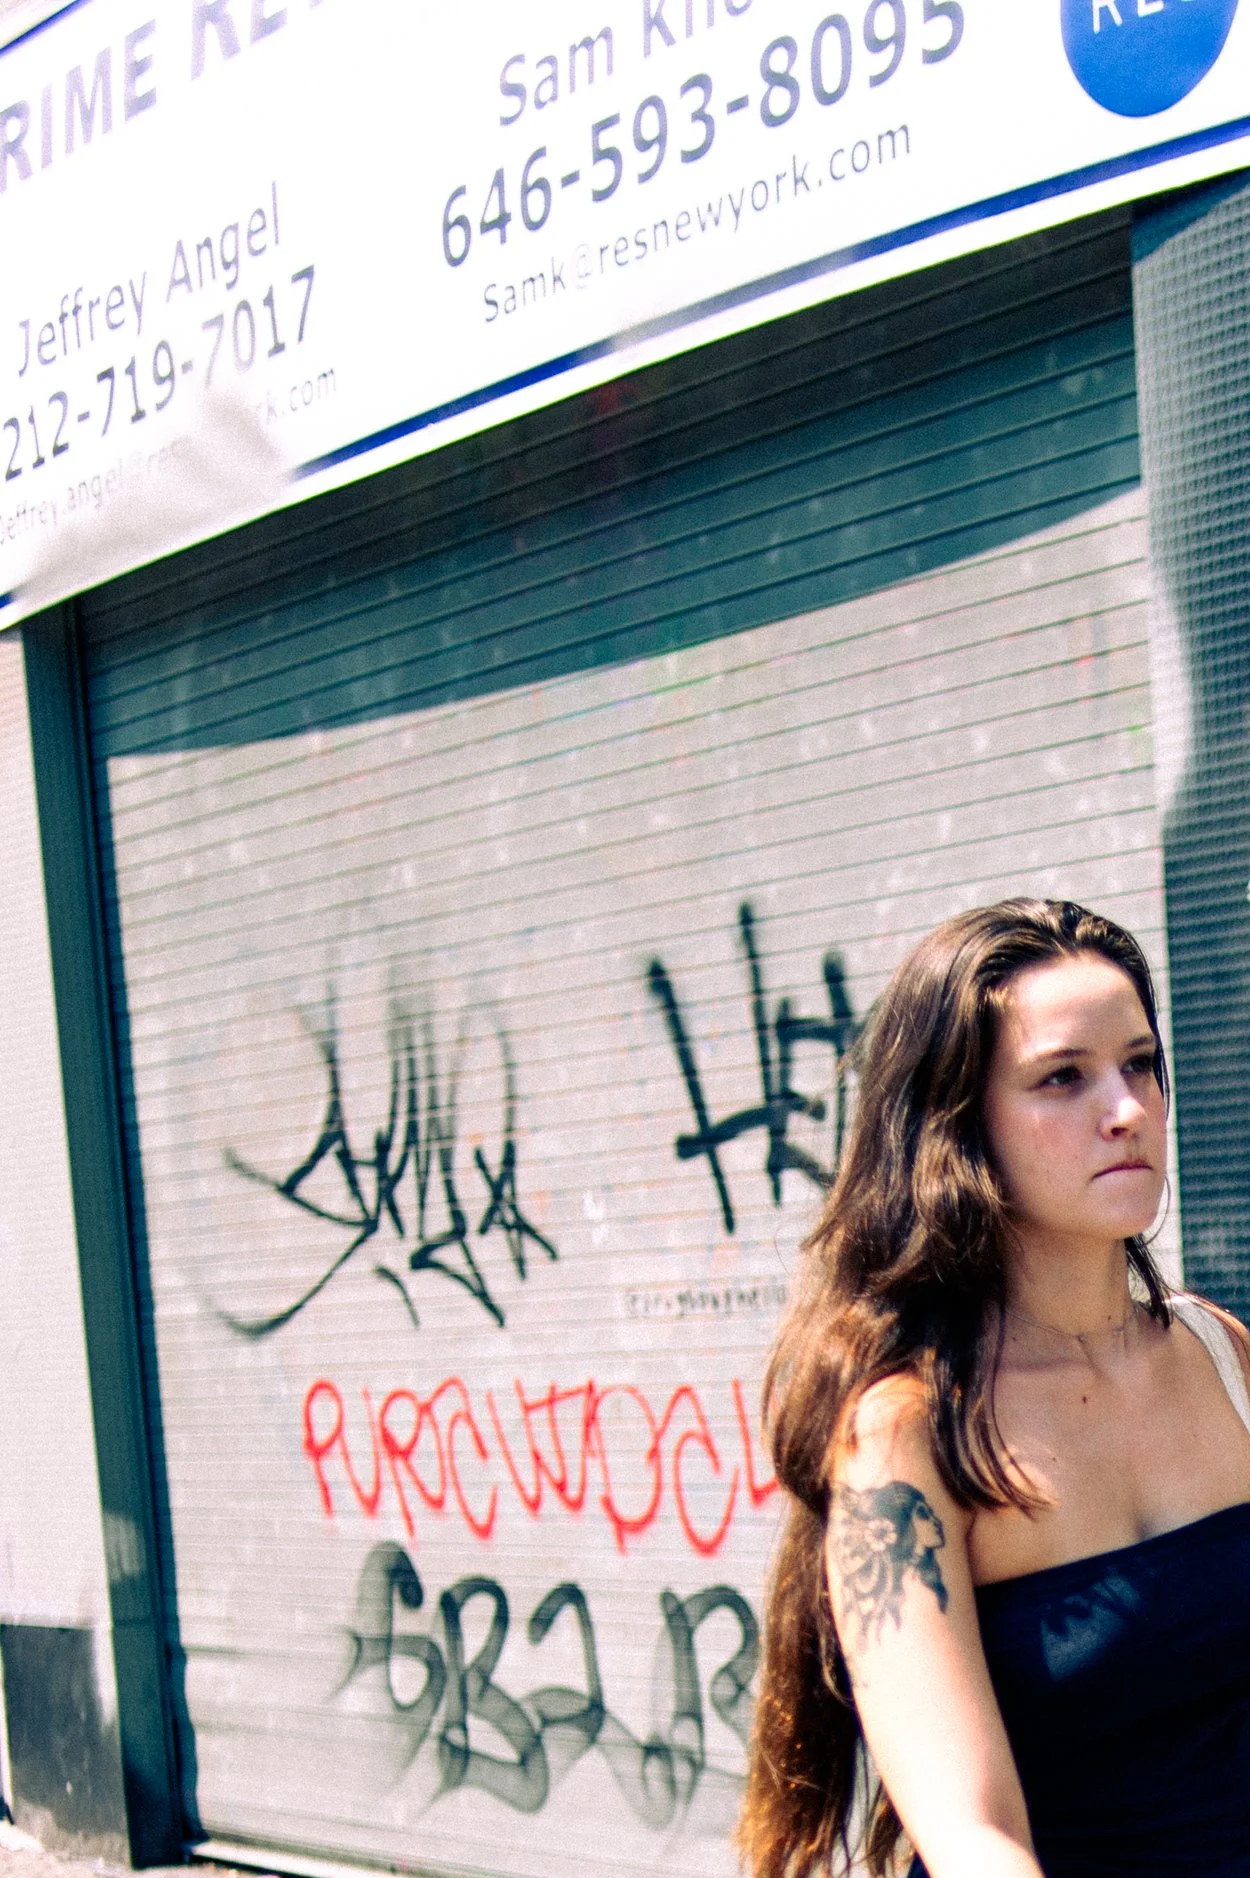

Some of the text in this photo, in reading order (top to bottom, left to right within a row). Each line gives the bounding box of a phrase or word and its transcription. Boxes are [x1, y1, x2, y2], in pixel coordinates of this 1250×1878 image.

[441, 0, 965, 268] 646-593-8095
[499, 26, 613, 126] Sam
[18, 181, 281, 377] Jeffrey Angel
[484, 122, 912, 323] Samk@resnewyork.com
[3, 265, 317, 482] 212-719-7017
